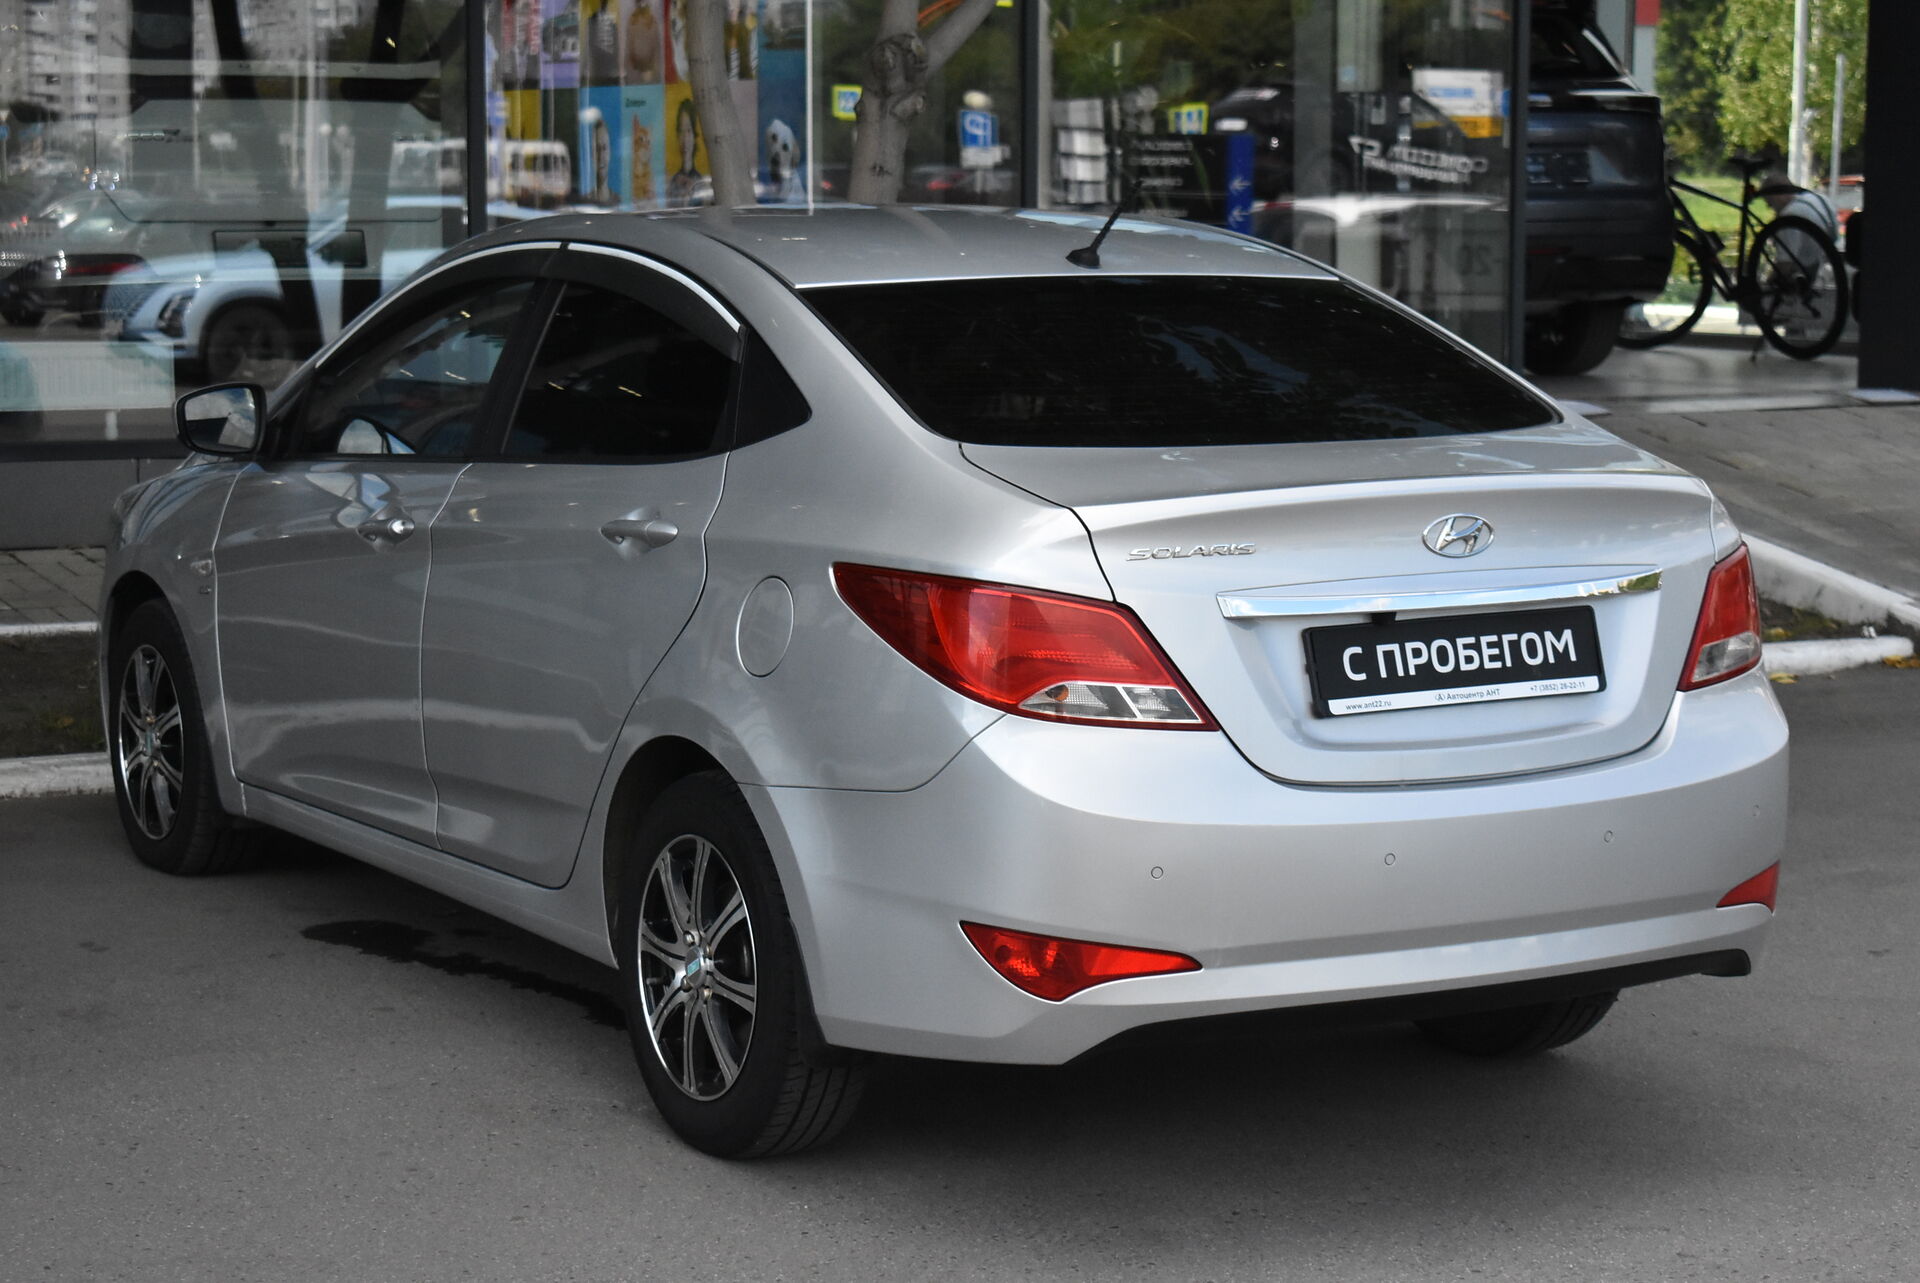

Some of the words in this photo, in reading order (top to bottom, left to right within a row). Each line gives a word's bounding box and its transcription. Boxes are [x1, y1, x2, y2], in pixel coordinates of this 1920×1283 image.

[1126, 542, 1257, 562] SOLARIS
[1343, 646, 1367, 681] С
[1376, 628, 1577, 678] ПРОБЕГОМ
[1446, 690, 1485, 701] Автоцентр
[1485, 688, 1501, 697] АНТ
[1345, 700, 1392, 712] www.ant22.ru
